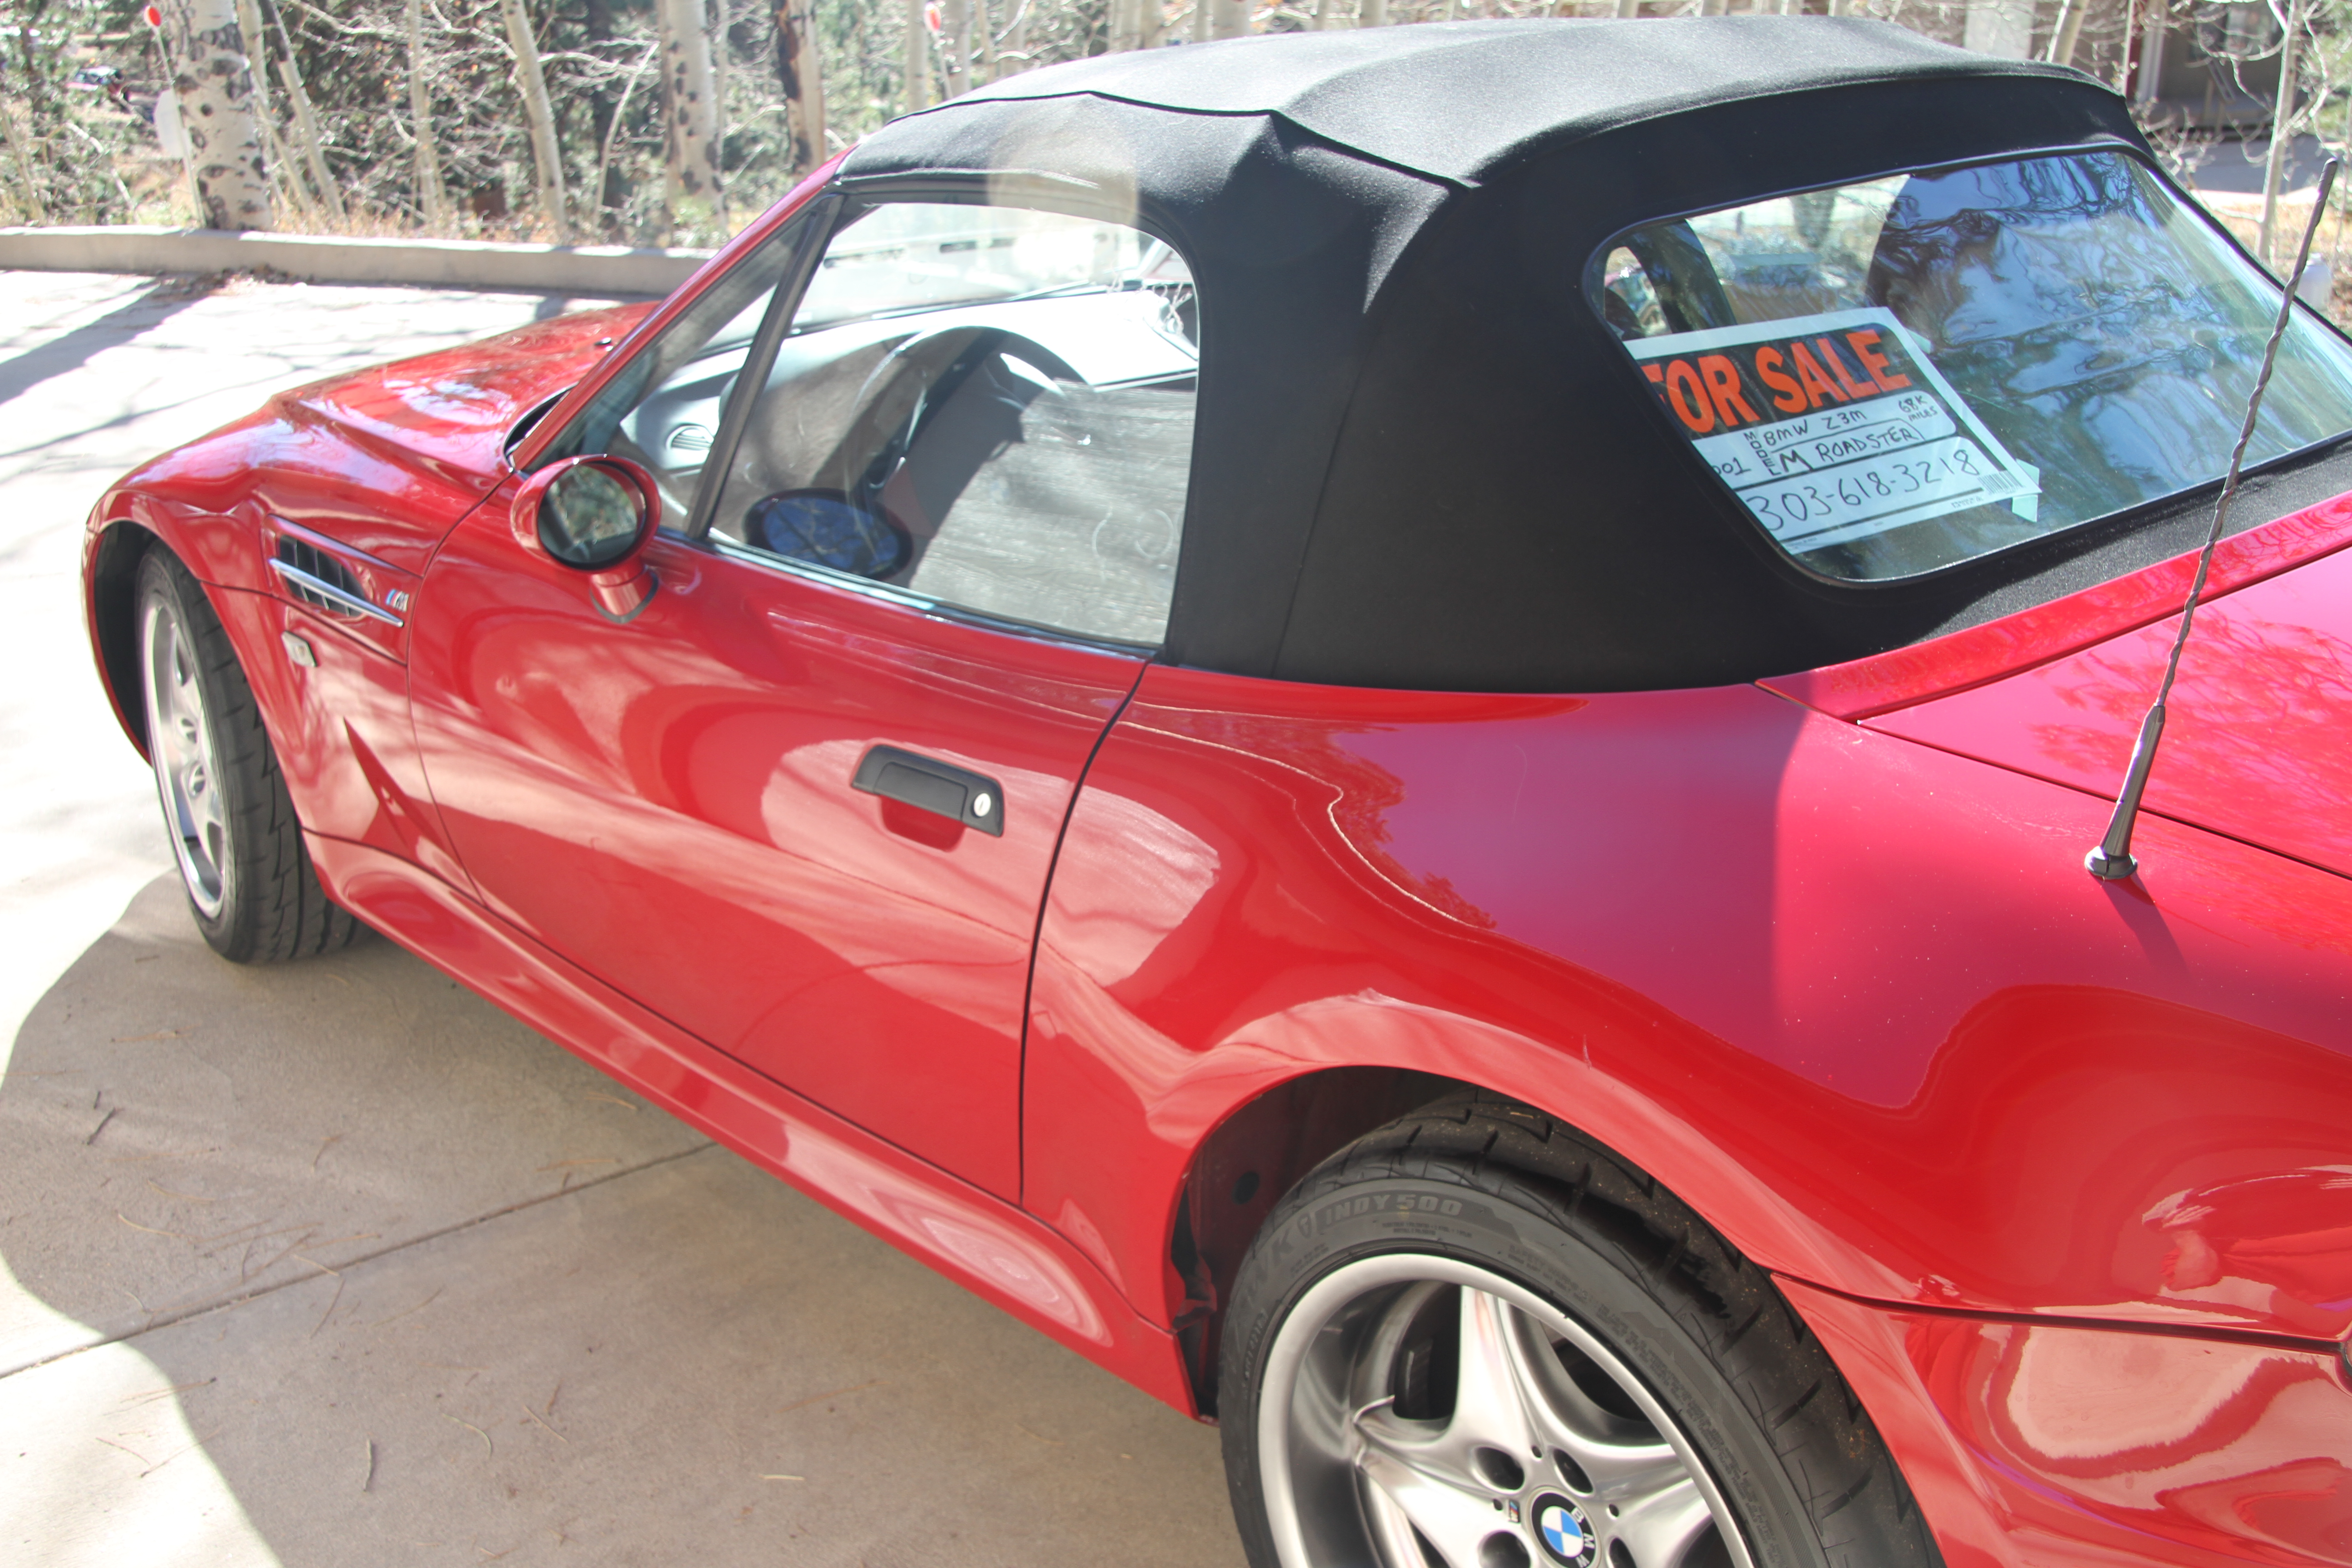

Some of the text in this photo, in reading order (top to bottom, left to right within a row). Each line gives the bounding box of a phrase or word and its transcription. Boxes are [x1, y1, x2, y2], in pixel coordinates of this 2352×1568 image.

[1755, 329, 1912, 412] SALE
[1898, 395, 1928, 412] 68K
[1764, 410, 1867, 446] BMW Z3M
[1779, 426, 1919, 473] M ROADSTER
[1744, 431, 1781, 475] MODEL
[1746, 450, 1980, 531] 303-618-3218
[1326, 1194, 1463, 1225] INDY 500
[1571, 1507, 1595, 1568] BMW
